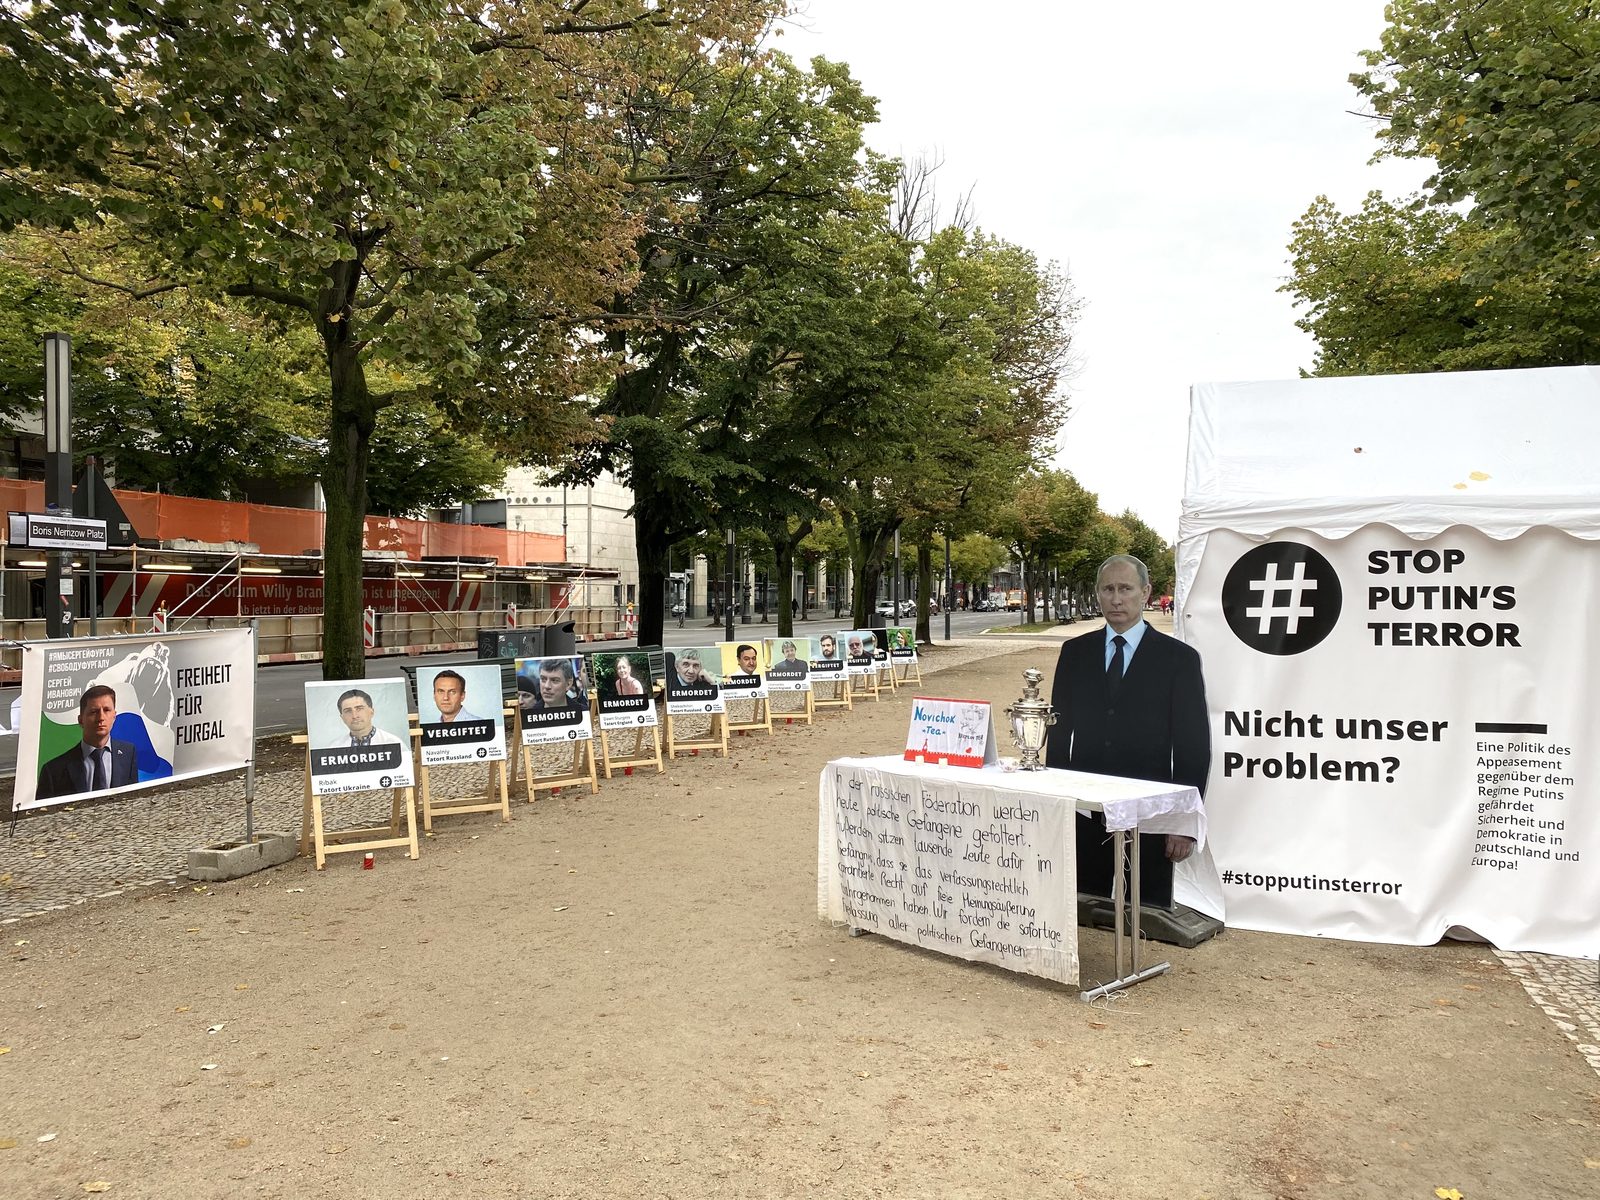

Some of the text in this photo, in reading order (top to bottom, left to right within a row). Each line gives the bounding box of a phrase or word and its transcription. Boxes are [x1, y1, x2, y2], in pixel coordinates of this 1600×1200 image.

[32, 525, 52, 536] Boris
[53, 527, 85, 538] Nemzow
[86, 528, 105, 540] Platz
[1367, 548, 1466, 574] STOP
[185, 583, 211, 598] Das
[216, 583, 258, 598] Forum
[262, 583, 294, 602] Willy
[296, 584, 324, 598] Bran
[371, 585, 384, 599] ist
[1368, 586, 1516, 611] PUTIN'S
[252, 604, 271, 616] jetzt
[273, 604, 281, 614] in
[283, 604, 296, 614] der
[1367, 622, 1522, 648] TERROR
[48, 676, 72, 688] СЕРГЕЙ
[177, 664, 232, 688] FREIHEIT
[47, 688, 82, 699] ИВАНОВИЧ
[46, 699, 74, 710] ФУРГАЛ
[177, 694, 202, 717] FÜR
[603, 698, 644, 708] ERMORDET
[527, 710, 576, 722] ERMORDET
[176, 720, 225, 746] FURGAL
[427, 726, 487, 738] VERGIFTET
[1224, 709, 1449, 742] Nicht unser
[1476, 742, 1571, 756] Eine Politik des
[320, 752, 392, 766] ERMORDET
[1476, 756, 1562, 770] Appeasement
[1223, 752, 1401, 784] Problem?
[318, 778, 338, 786] Ribak
[1477, 771, 1574, 786] gegenüber dem
[320, 784, 370, 794] Tatort Ukraine
[848, 772, 864, 790] der
[921, 790, 981, 818] Föderation
[993, 800, 1040, 822] werden
[1478, 786, 1564, 800] Regime Putins
[836, 786, 859, 812] heute
[906, 810, 962, 840] Gefangene
[1478, 800, 1534, 814] gefährdet
[1478, 814, 1564, 830] Sicherheit und
[1476, 829, 1562, 846] Demokratie in
[914, 831, 953, 858] tausende
[962, 844, 990, 865] Leute
[996, 846, 1024, 870] dafür
[1037, 853, 1052, 874] im
[1474, 843, 1580, 862] Deutschland und
[876, 848, 894, 868] dass
[914, 856, 932, 880] das
[1472, 856, 1518, 870] Europa!
[880, 871, 904, 891] Recht
[911, 882, 928, 896] auf
[1222, 870, 1403, 895] #stopputinsterror
[933, 900, 948, 920] Wir
[997, 914, 1010, 930] die
[1018, 920, 1062, 948] sofortige
[888, 913, 909, 932] aller
[970, 929, 1026, 960] Gefangenen
